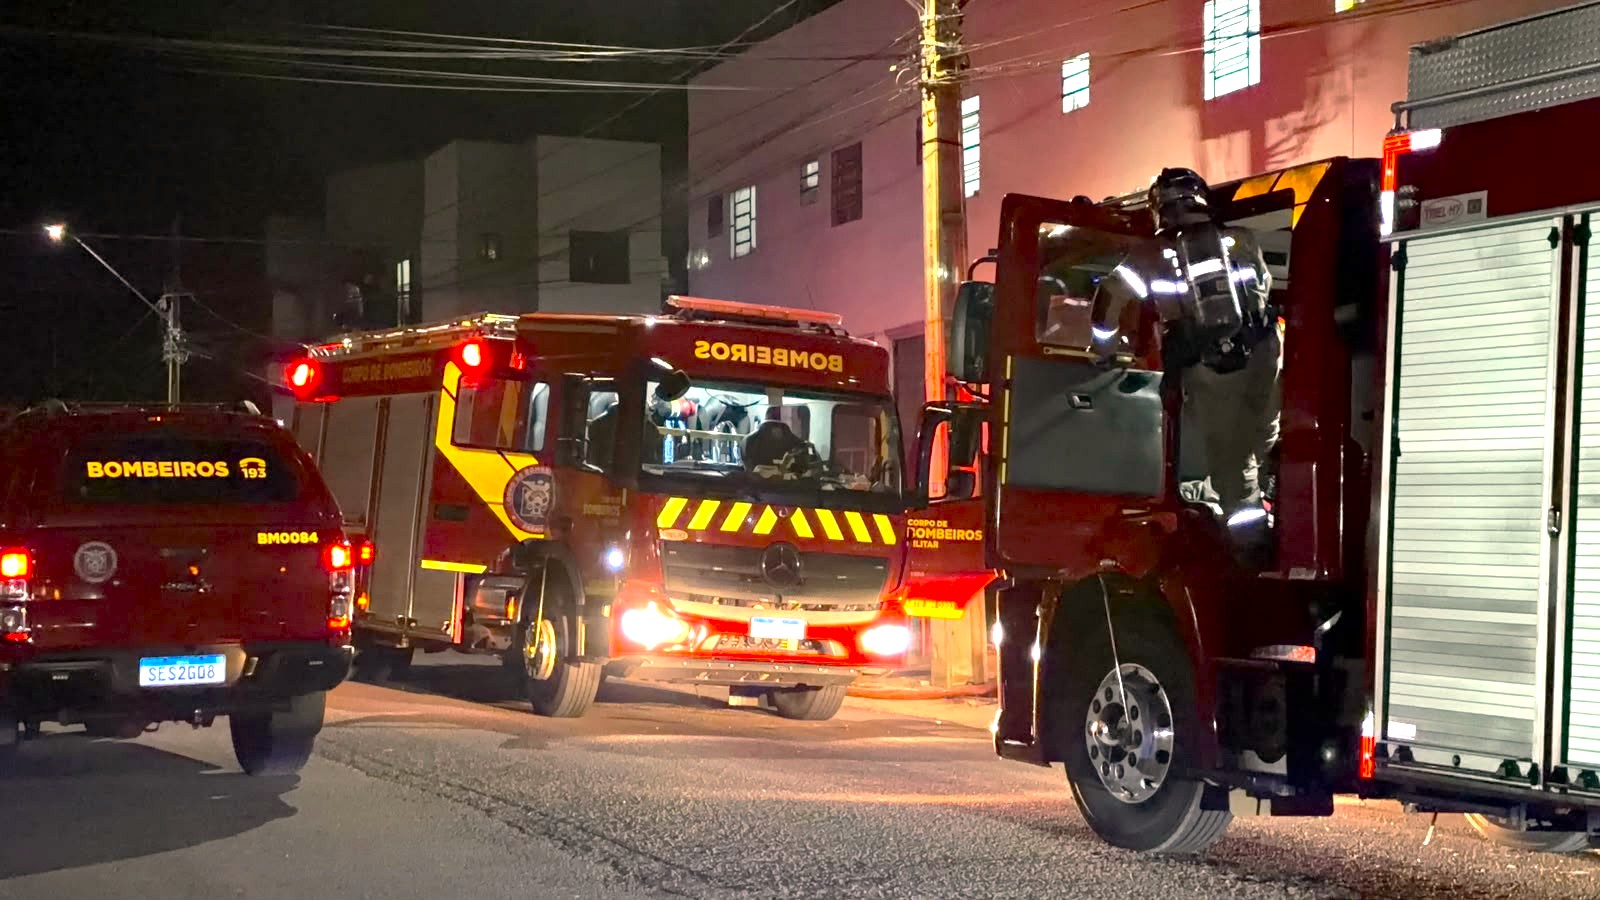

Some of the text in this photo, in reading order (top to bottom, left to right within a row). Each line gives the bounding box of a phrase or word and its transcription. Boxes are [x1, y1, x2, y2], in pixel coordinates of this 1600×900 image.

[87, 461, 229, 478] BOMBEIROS
[243, 467, 266, 479] 193
[907, 519, 948, 528] CORPO DE
[906, 540, 939, 549] ILITAR
[148, 665, 215, 681] SES2G08
